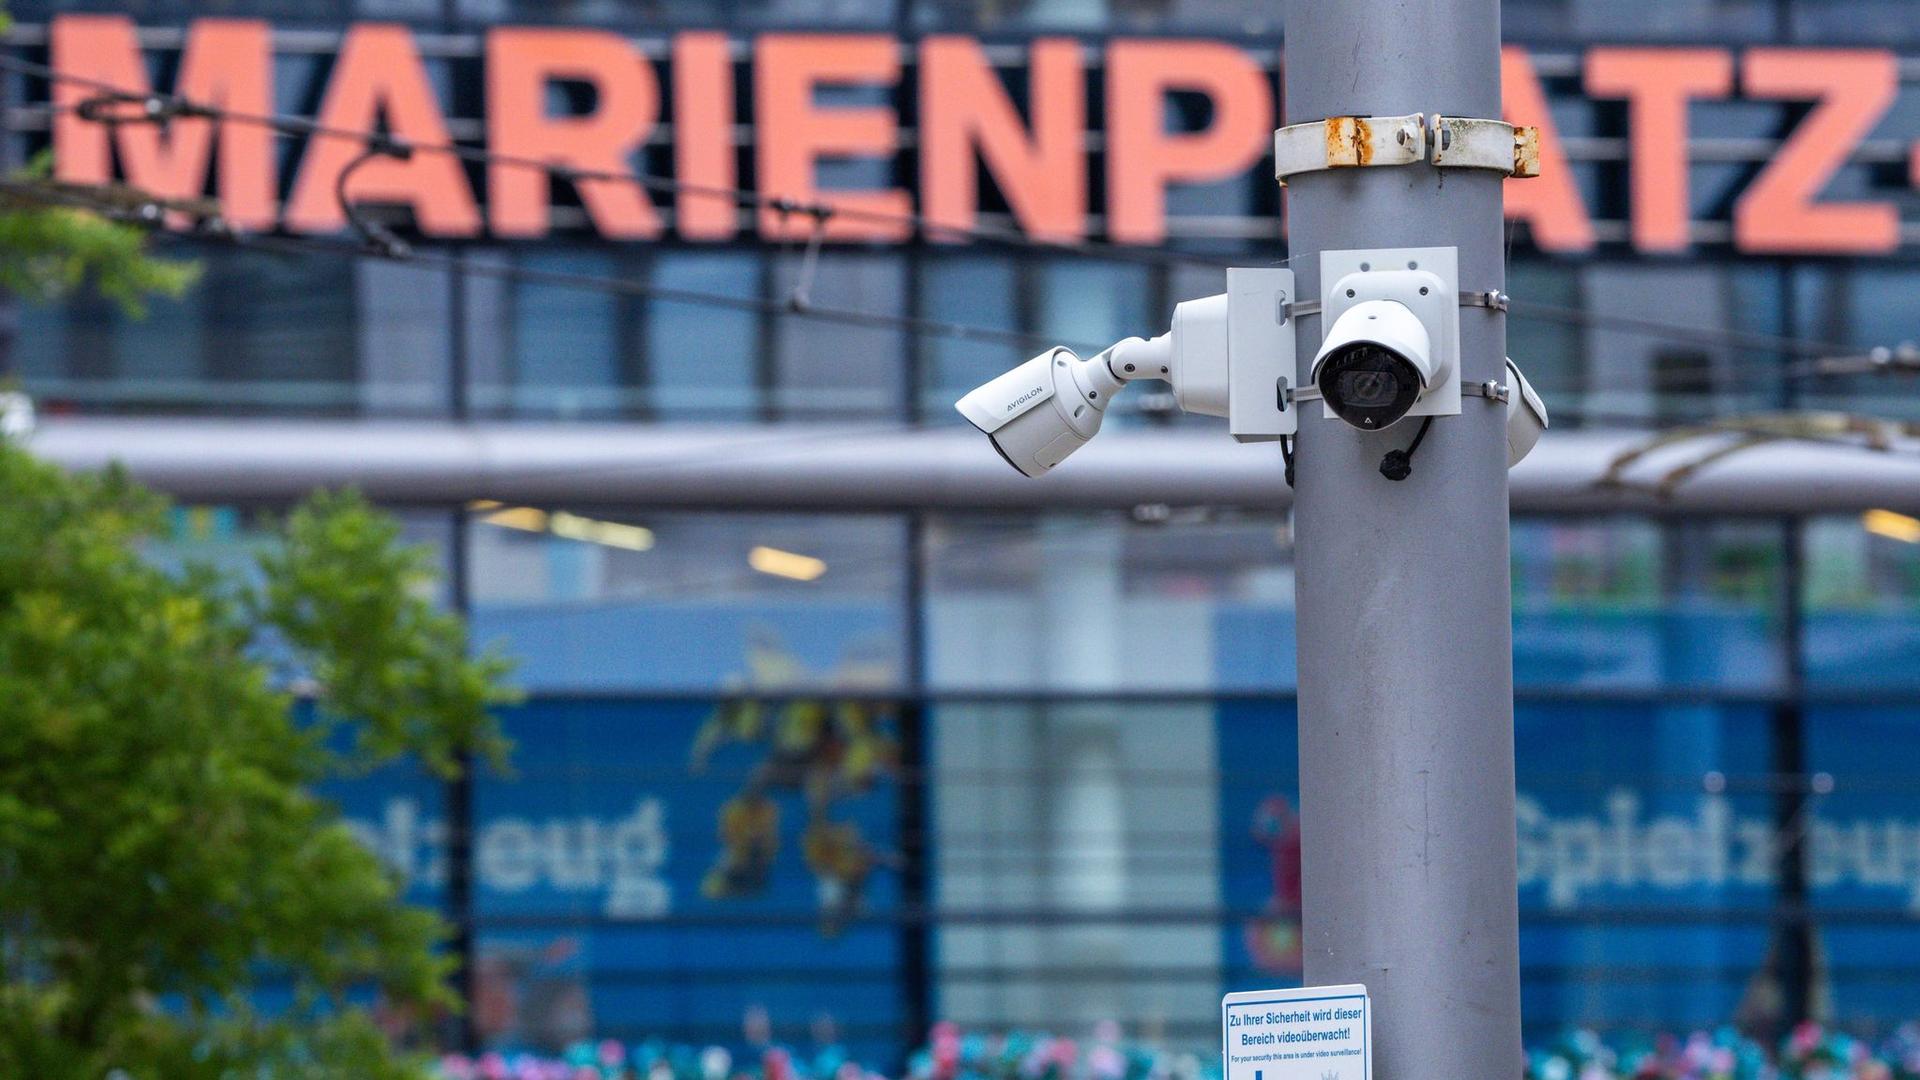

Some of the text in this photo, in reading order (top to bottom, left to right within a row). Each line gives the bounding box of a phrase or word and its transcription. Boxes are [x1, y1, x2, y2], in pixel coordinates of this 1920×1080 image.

[50, 17, 1900, 255] MARIENPATZ
[1007, 386, 1043, 411] AVIGILON
[1230, 1008, 1362, 1026] Zu Ihrer Sicherheit wird dieser
[1242, 1027, 1350, 1045] Bereich videoüberwacht!
[1252, 1054, 1272, 1062] security
